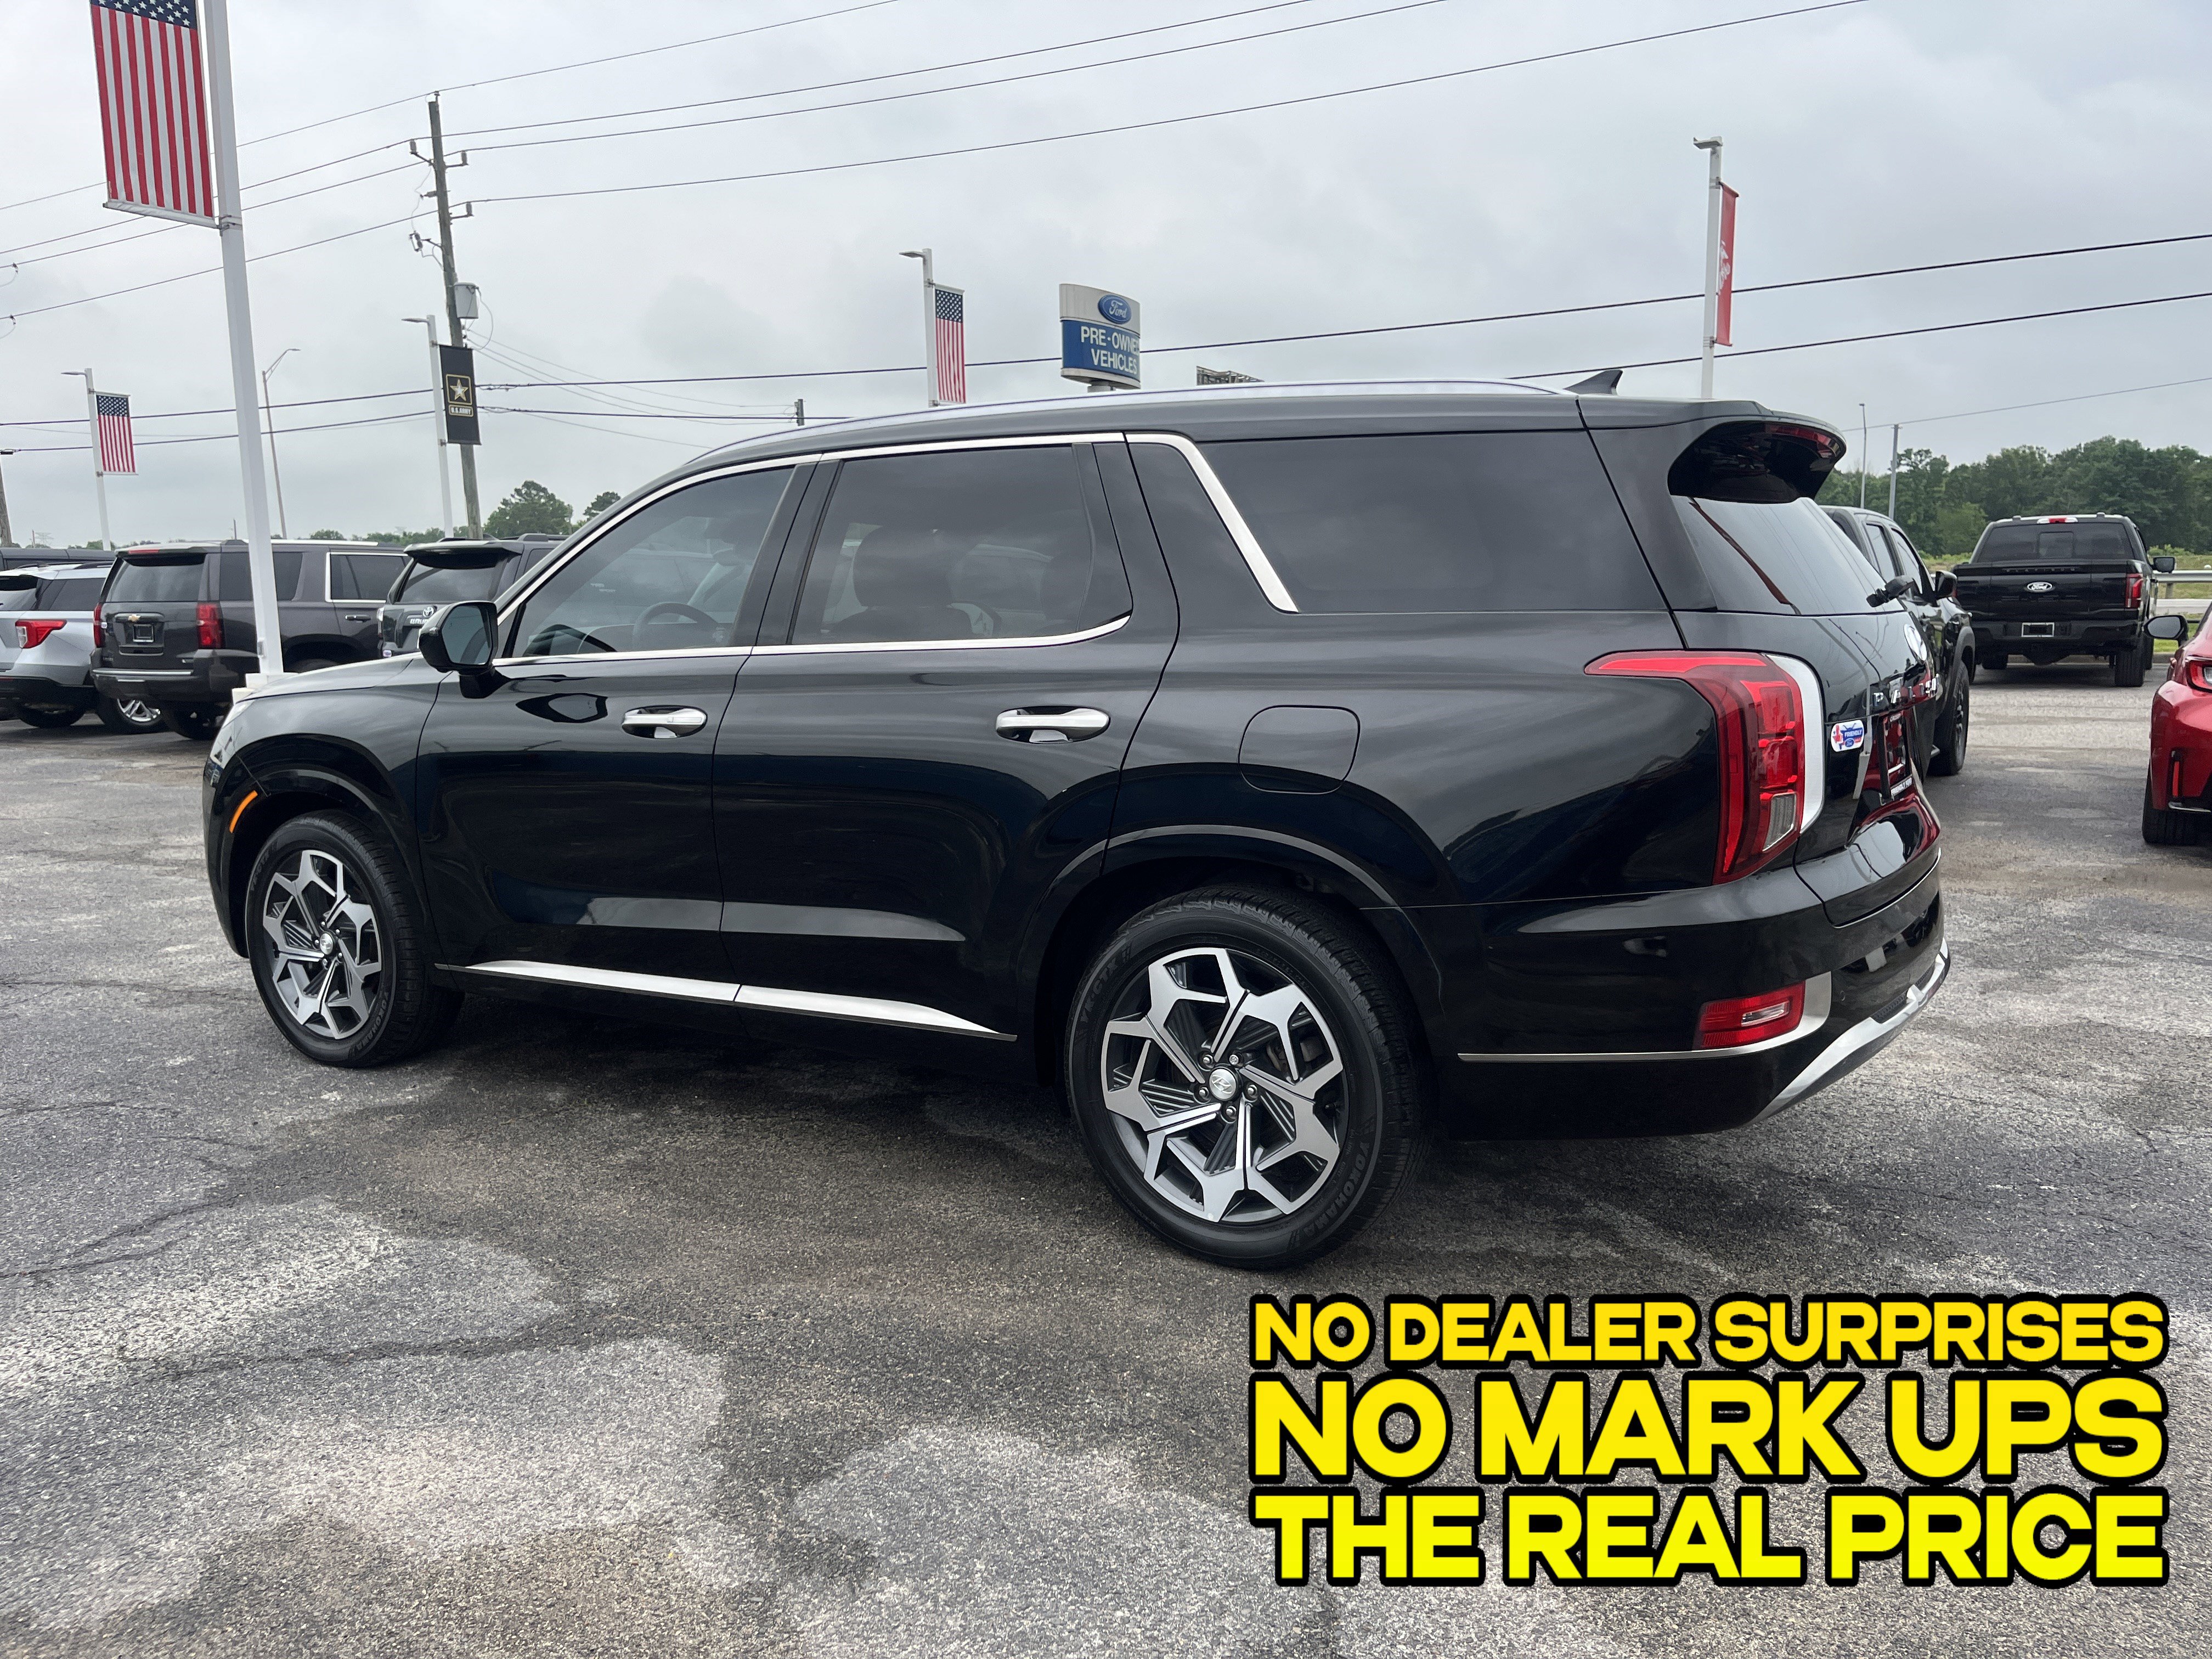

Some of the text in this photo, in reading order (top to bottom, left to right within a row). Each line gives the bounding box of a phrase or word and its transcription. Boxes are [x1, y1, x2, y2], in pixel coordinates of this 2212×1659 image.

[1109, 300, 1127, 318] Ford
[1091, 348, 1137, 375] VEHICLES
[1304, 1142, 1370, 1237] YOKOHAMA
